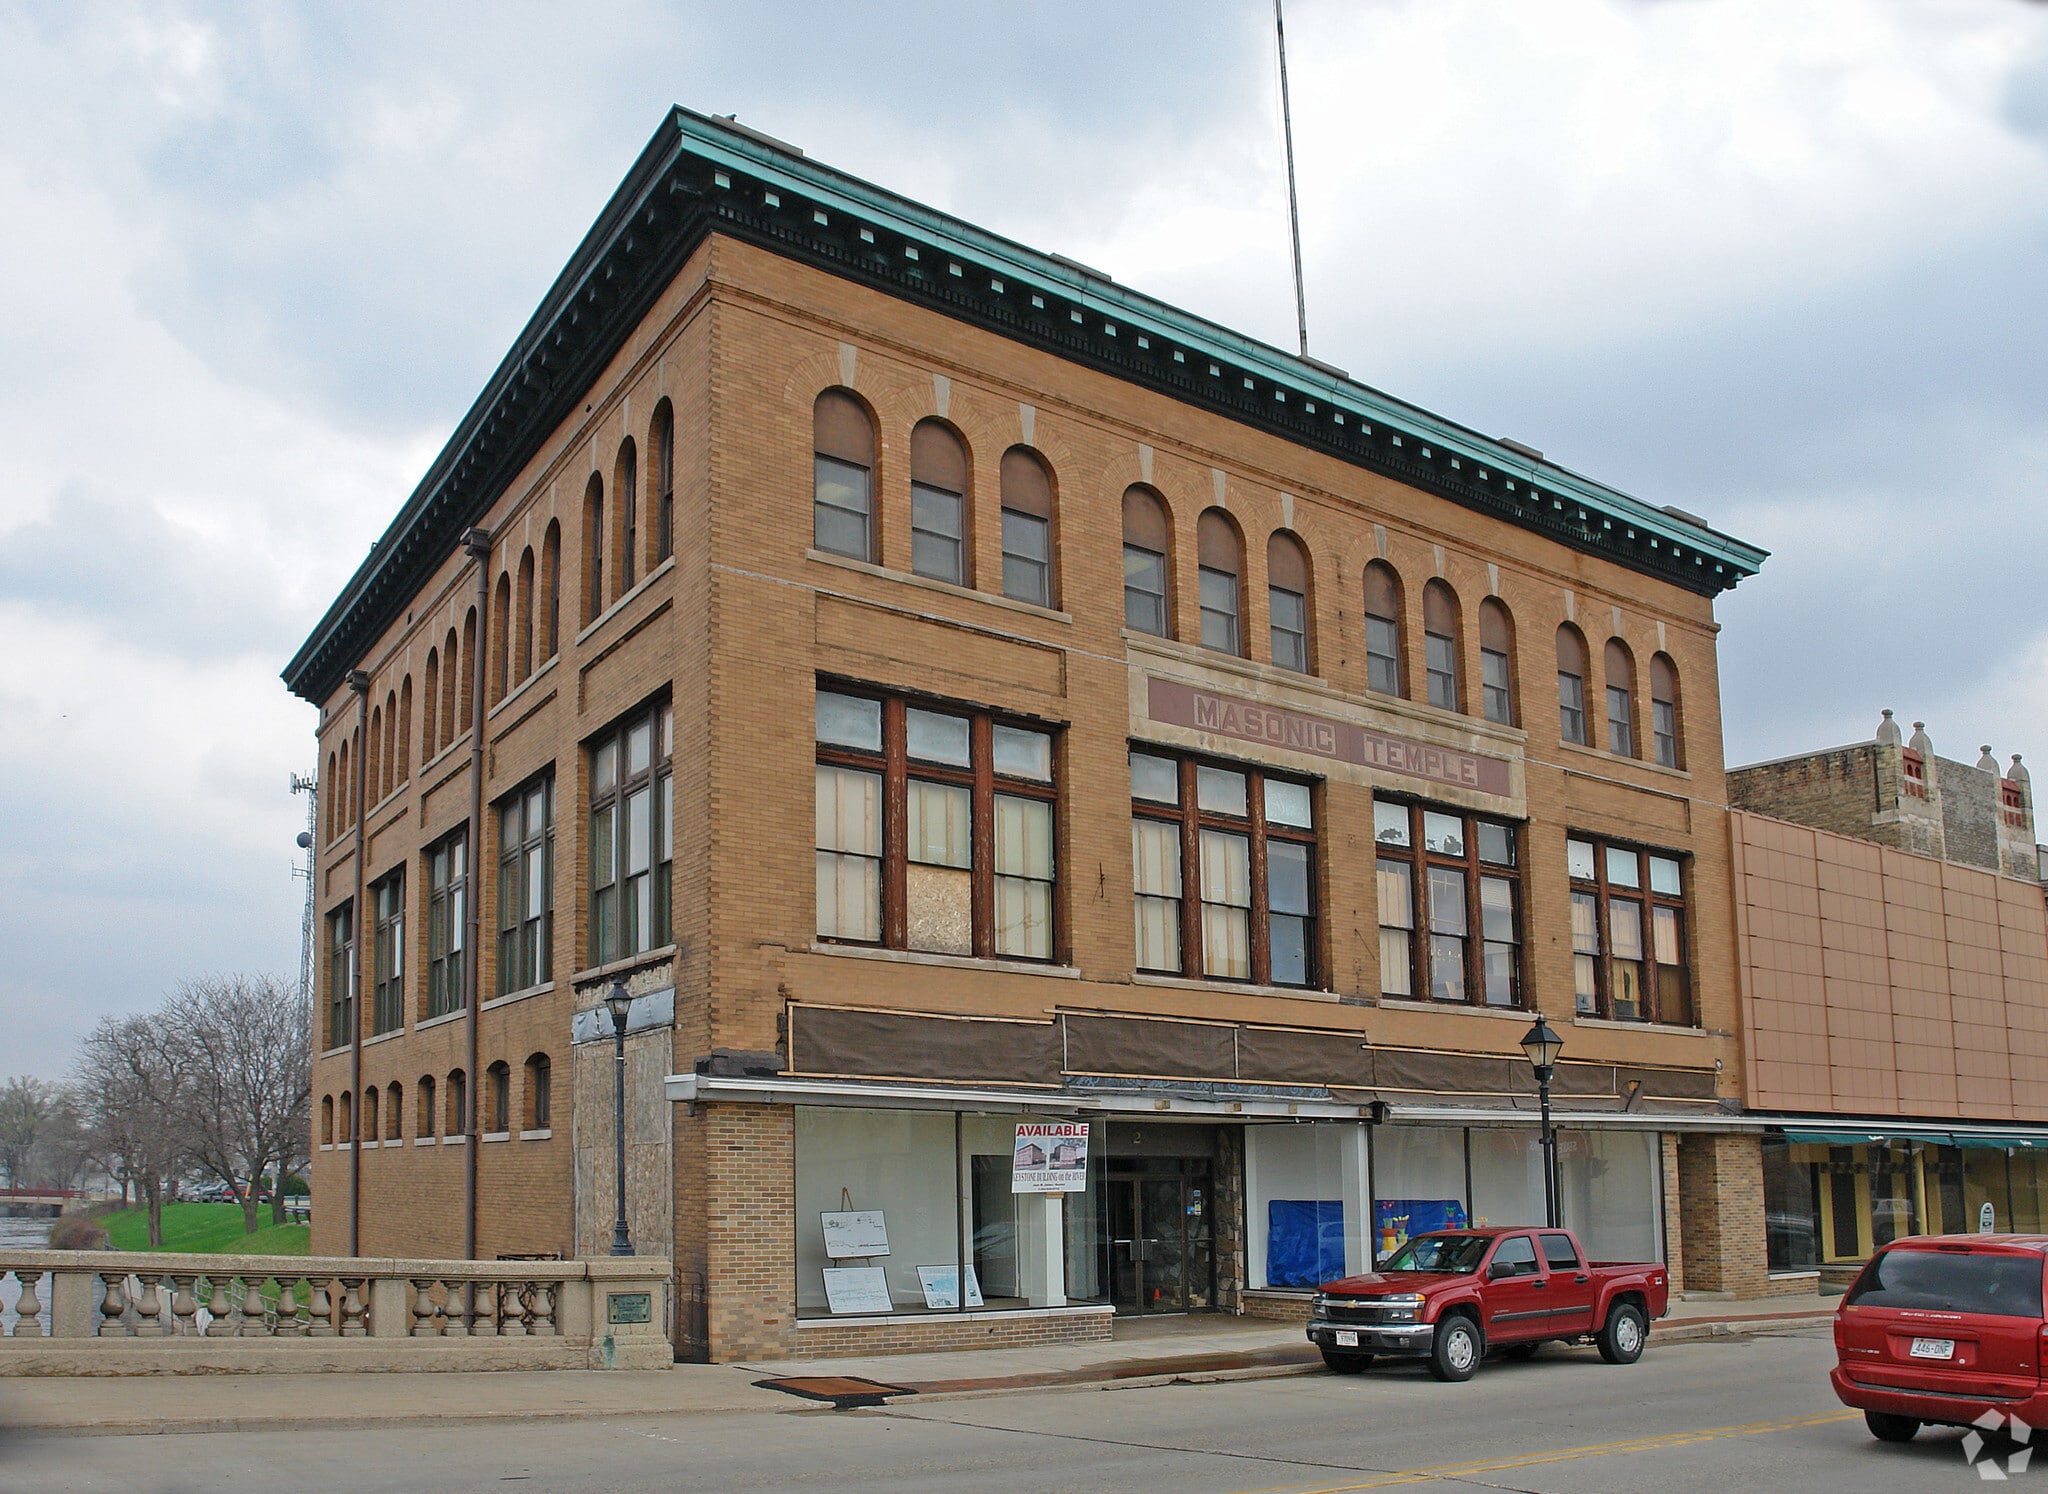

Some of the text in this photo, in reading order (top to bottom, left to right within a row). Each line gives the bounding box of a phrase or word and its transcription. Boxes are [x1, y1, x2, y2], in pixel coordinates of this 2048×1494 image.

[1196, 694, 1476, 785] MASONIC TEMPLE
[1016, 1125, 1089, 1137] AVAILABLE
[1133, 1131, 1142, 1144] 2
